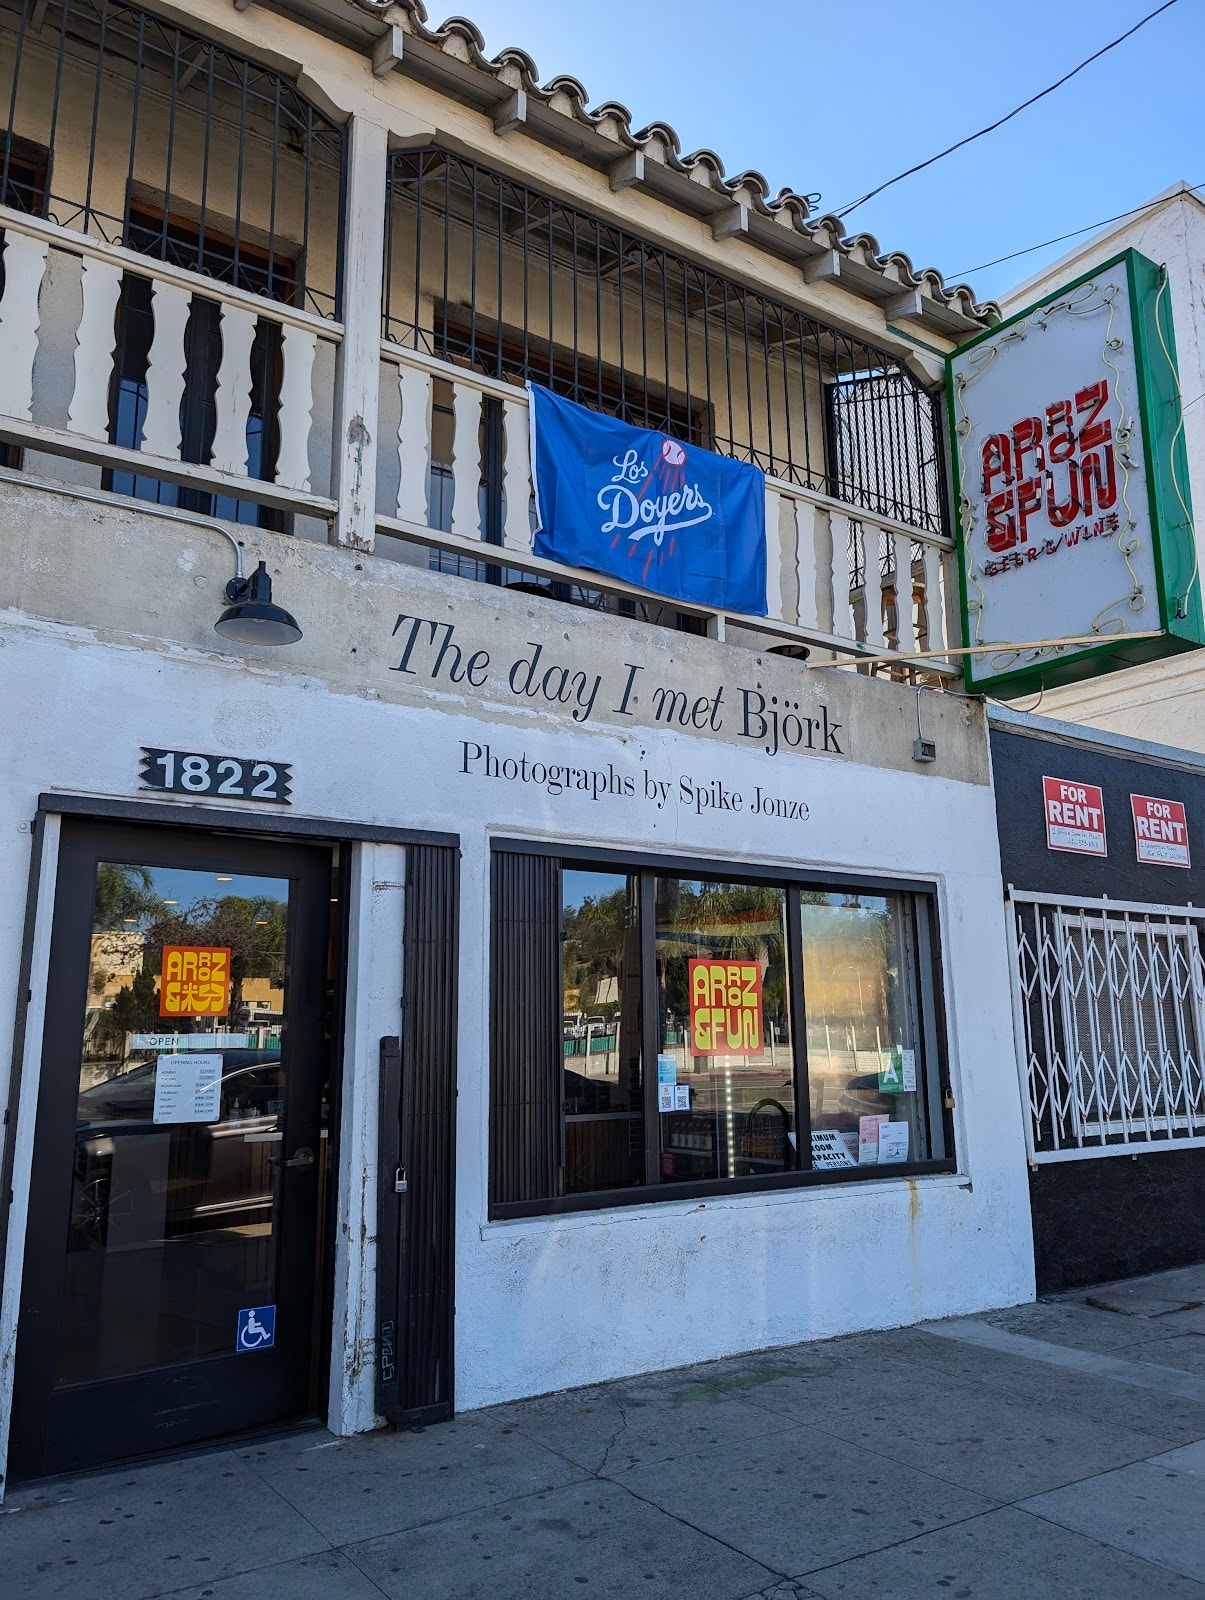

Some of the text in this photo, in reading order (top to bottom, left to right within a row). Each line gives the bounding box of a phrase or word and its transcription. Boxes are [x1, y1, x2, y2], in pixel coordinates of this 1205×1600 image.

[611, 449, 649, 484] Los
[597, 483, 713, 546] Doyers
[389, 614, 845, 757] The day I met Björk
[156, 752, 278, 799] 1822
[458, 740, 810, 821] Photographs by Spike Jonze
[1060, 785, 1087, 804] FOR
[1048, 799, 1101, 829] RENT
[1146, 801, 1171, 819] FOR
[1136, 815, 1184, 842] RENT
[166, 951, 227, 982] ARROZ
[693, 964, 758, 1007] ARROZ
[149, 1037, 179, 1046] OPEN
[883, 1057, 899, 1083] A
[811, 1133, 837, 1142] IMUM
[811, 1152, 846, 1161] APACITY
